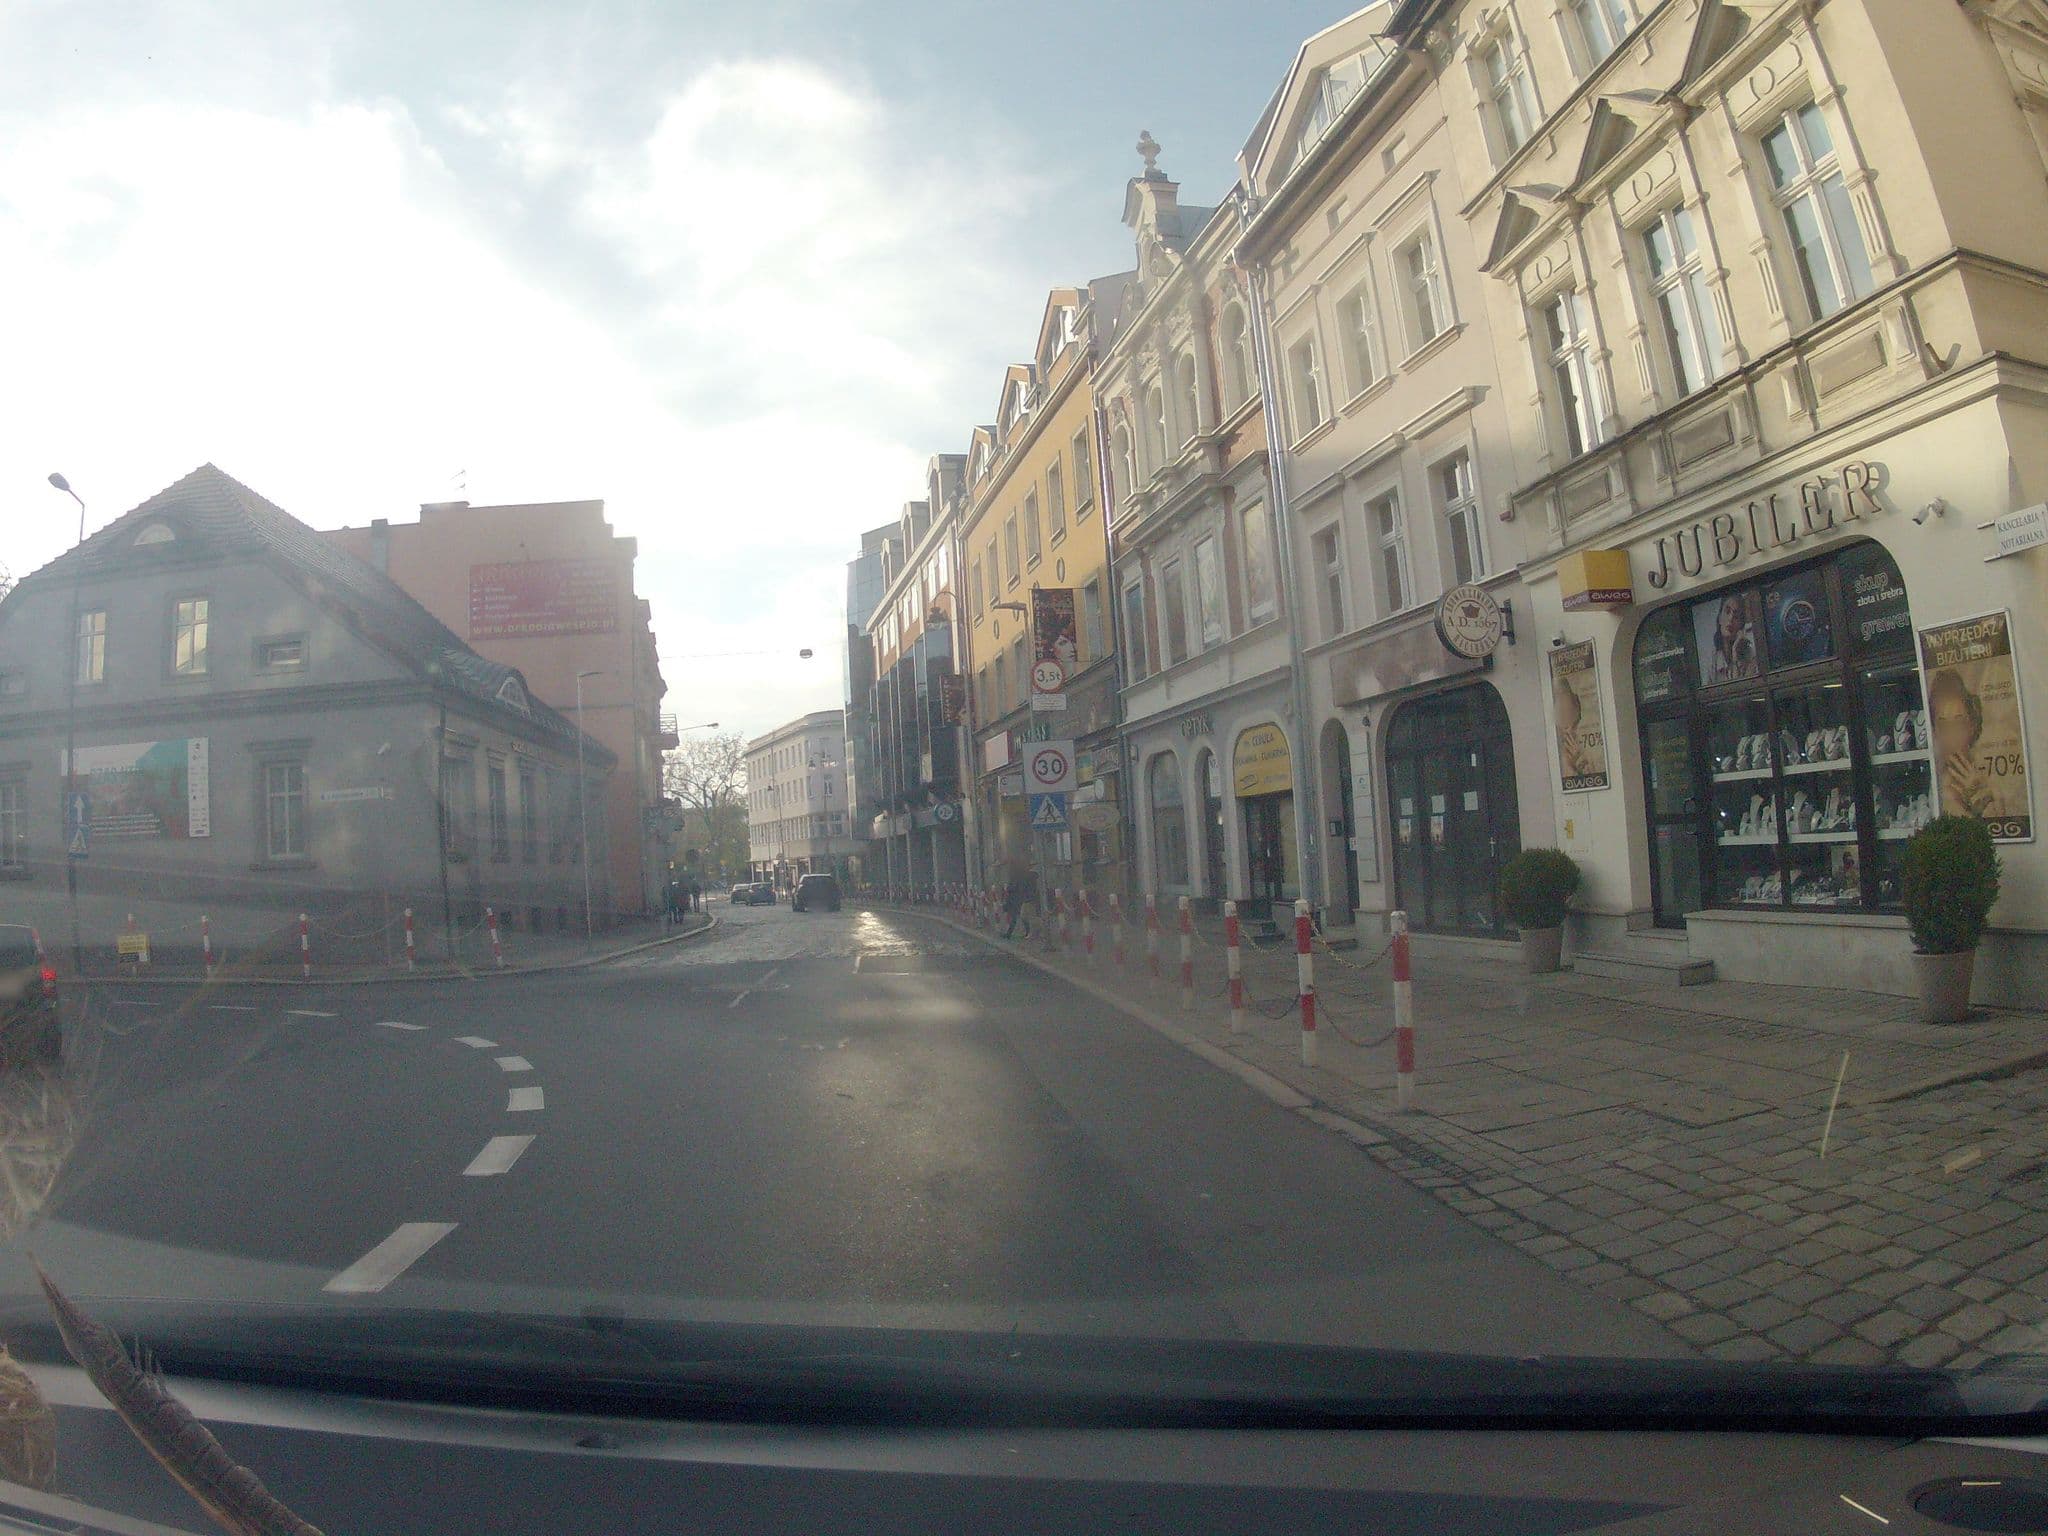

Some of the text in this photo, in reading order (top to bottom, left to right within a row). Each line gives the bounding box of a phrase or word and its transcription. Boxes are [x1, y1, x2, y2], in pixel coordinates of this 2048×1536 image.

[1648, 460, 1884, 589] JUBILER
[1997, 511, 2040, 533] KANCELARIA
[2000, 530, 2045, 551] NOTARIALNA
[1855, 571, 1889, 594] skup
[1880, 587, 1904, 601] srebra
[1036, 669, 1061, 683] 3,5t
[1180, 717, 1210, 737] OPTYK
[1579, 732, 1604, 748] -70%
[1037, 758, 1063, 776] 30
[1978, 753, 2025, 777] -70%
